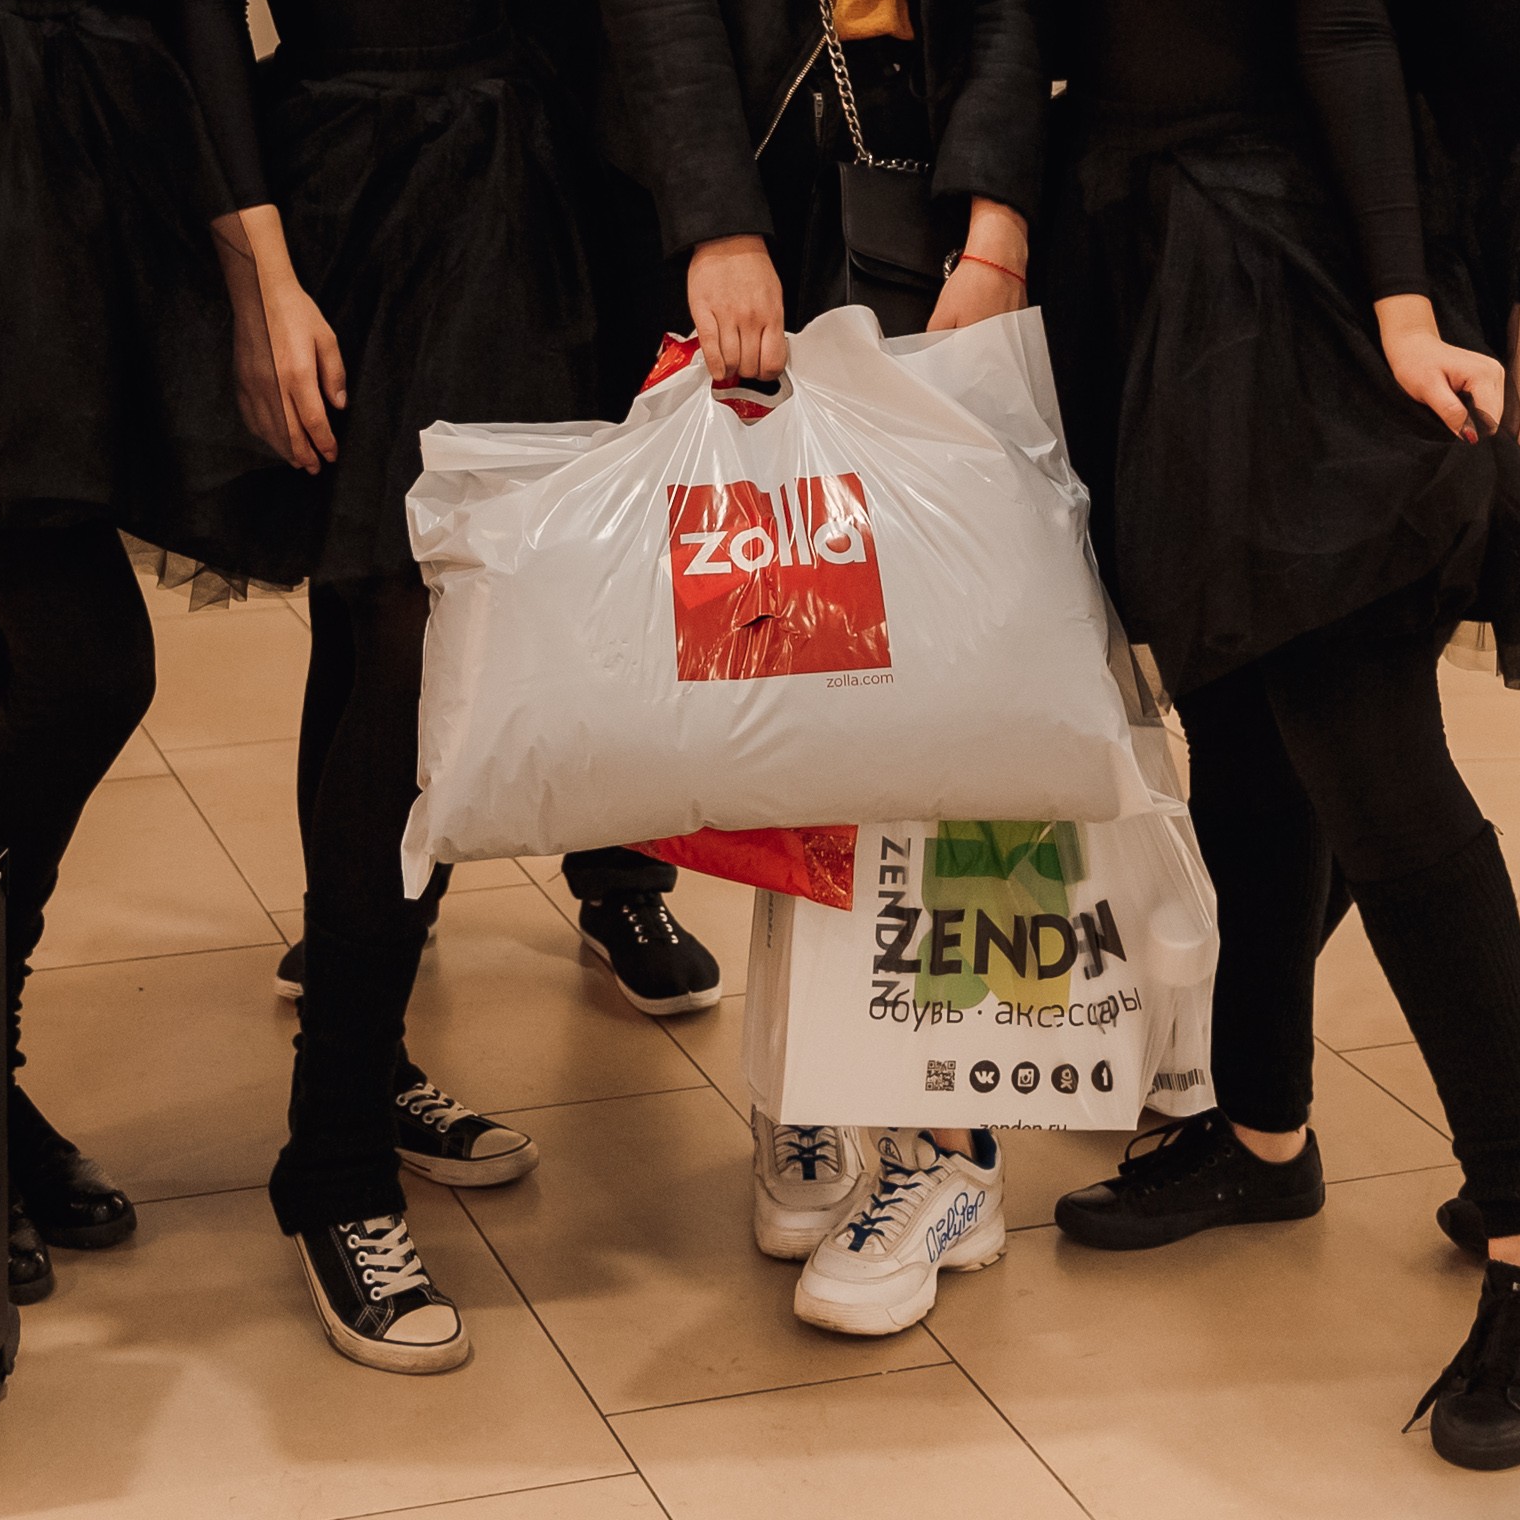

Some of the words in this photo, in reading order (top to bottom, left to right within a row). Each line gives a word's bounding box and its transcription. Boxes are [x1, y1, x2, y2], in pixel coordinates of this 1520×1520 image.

[680, 488, 867, 576] zolla
[826, 673, 894, 689] zolla.com
[869, 988, 965, 1033] обувь
